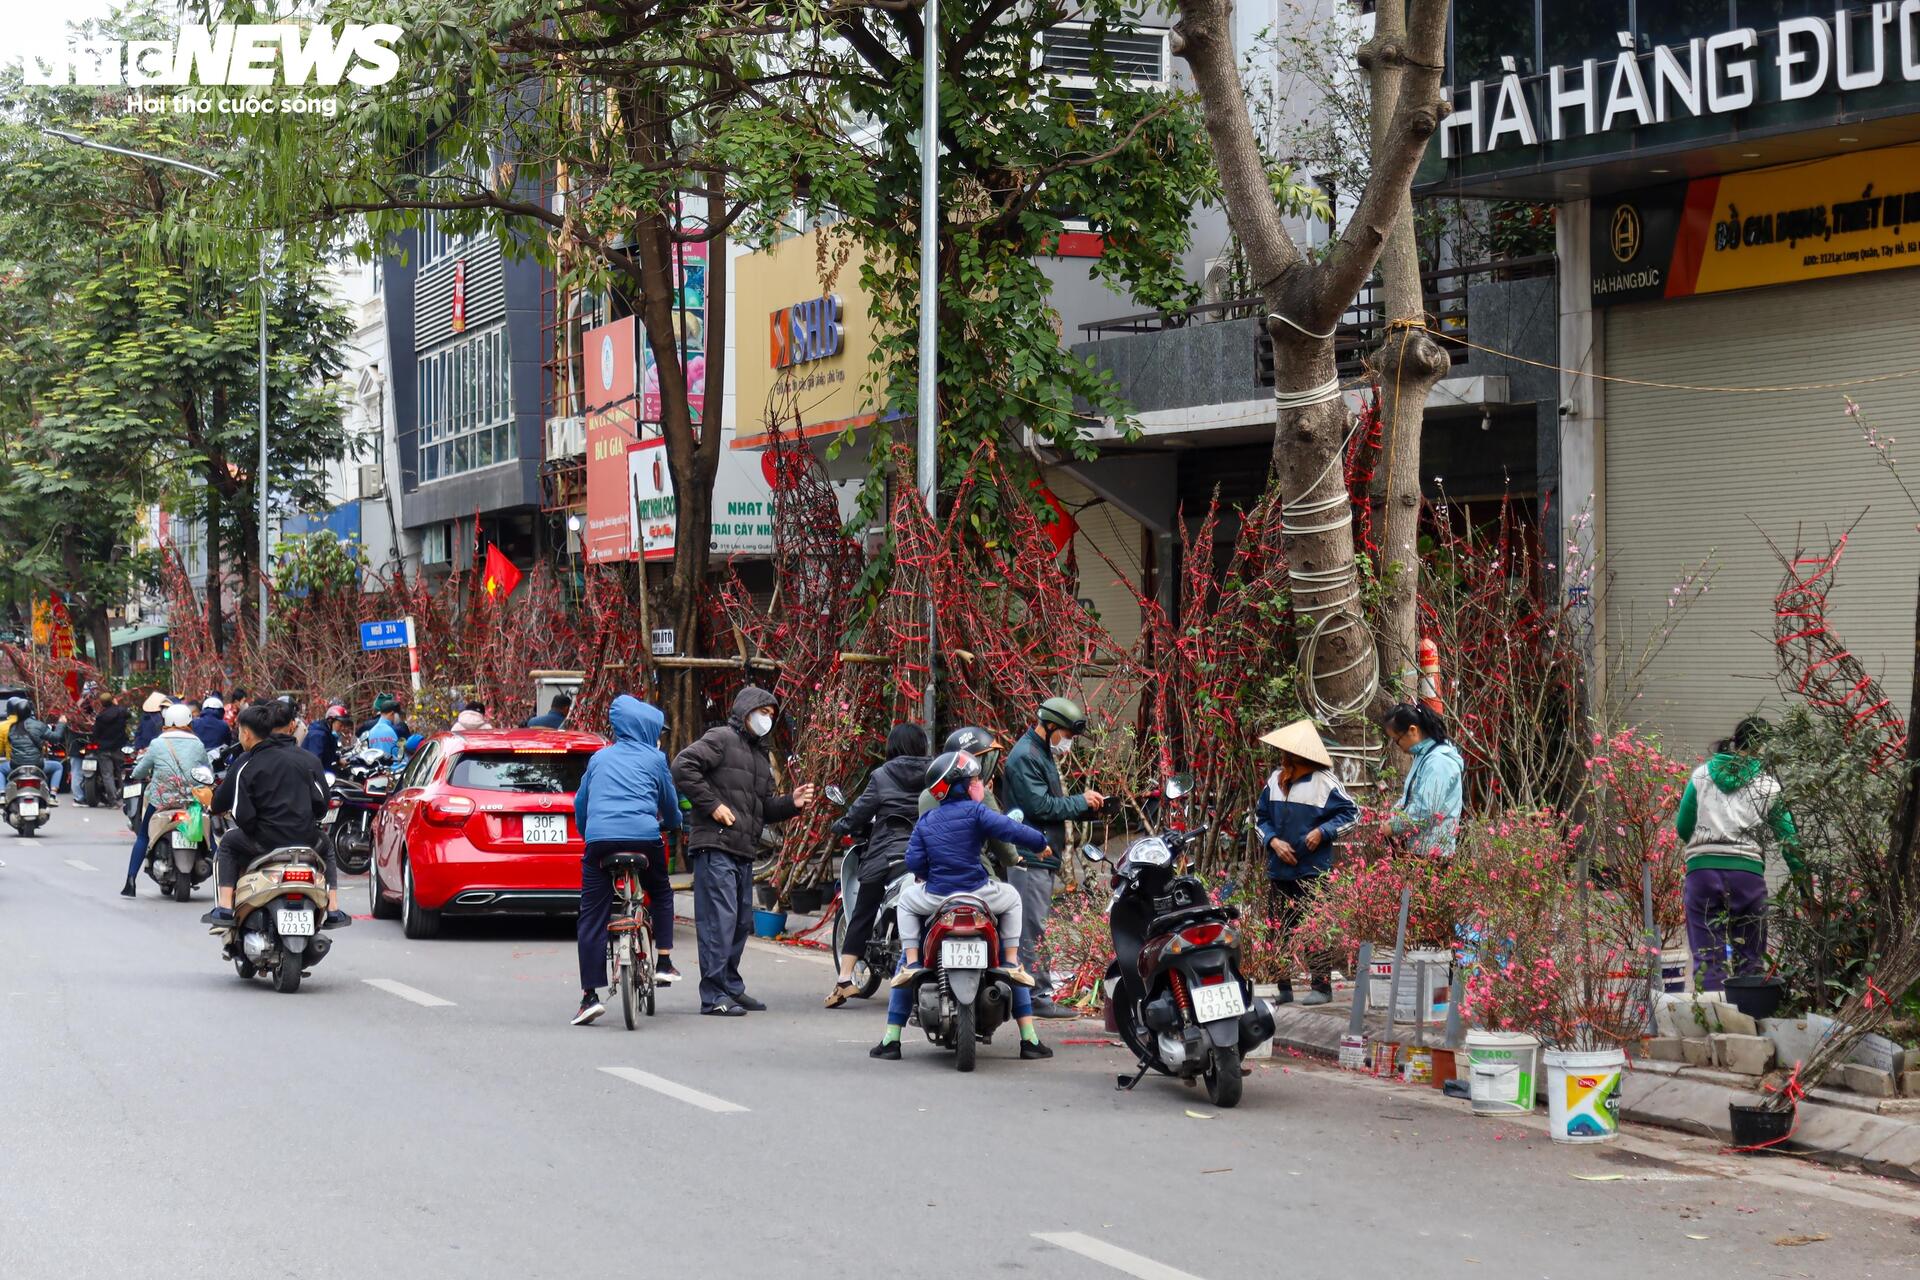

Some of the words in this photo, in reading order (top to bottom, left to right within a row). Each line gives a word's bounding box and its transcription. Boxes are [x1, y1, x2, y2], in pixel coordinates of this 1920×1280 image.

[1441, 55, 1538, 158] HÀ
[1551, 28, 1758, 140] HÀNG
[792, 294, 844, 364] SHB
[728, 502, 762, 516] NHAT
[734, 521, 754, 536] CÂY
[534, 816, 555, 828] 30F
[950, 955, 980, 966] 1287
